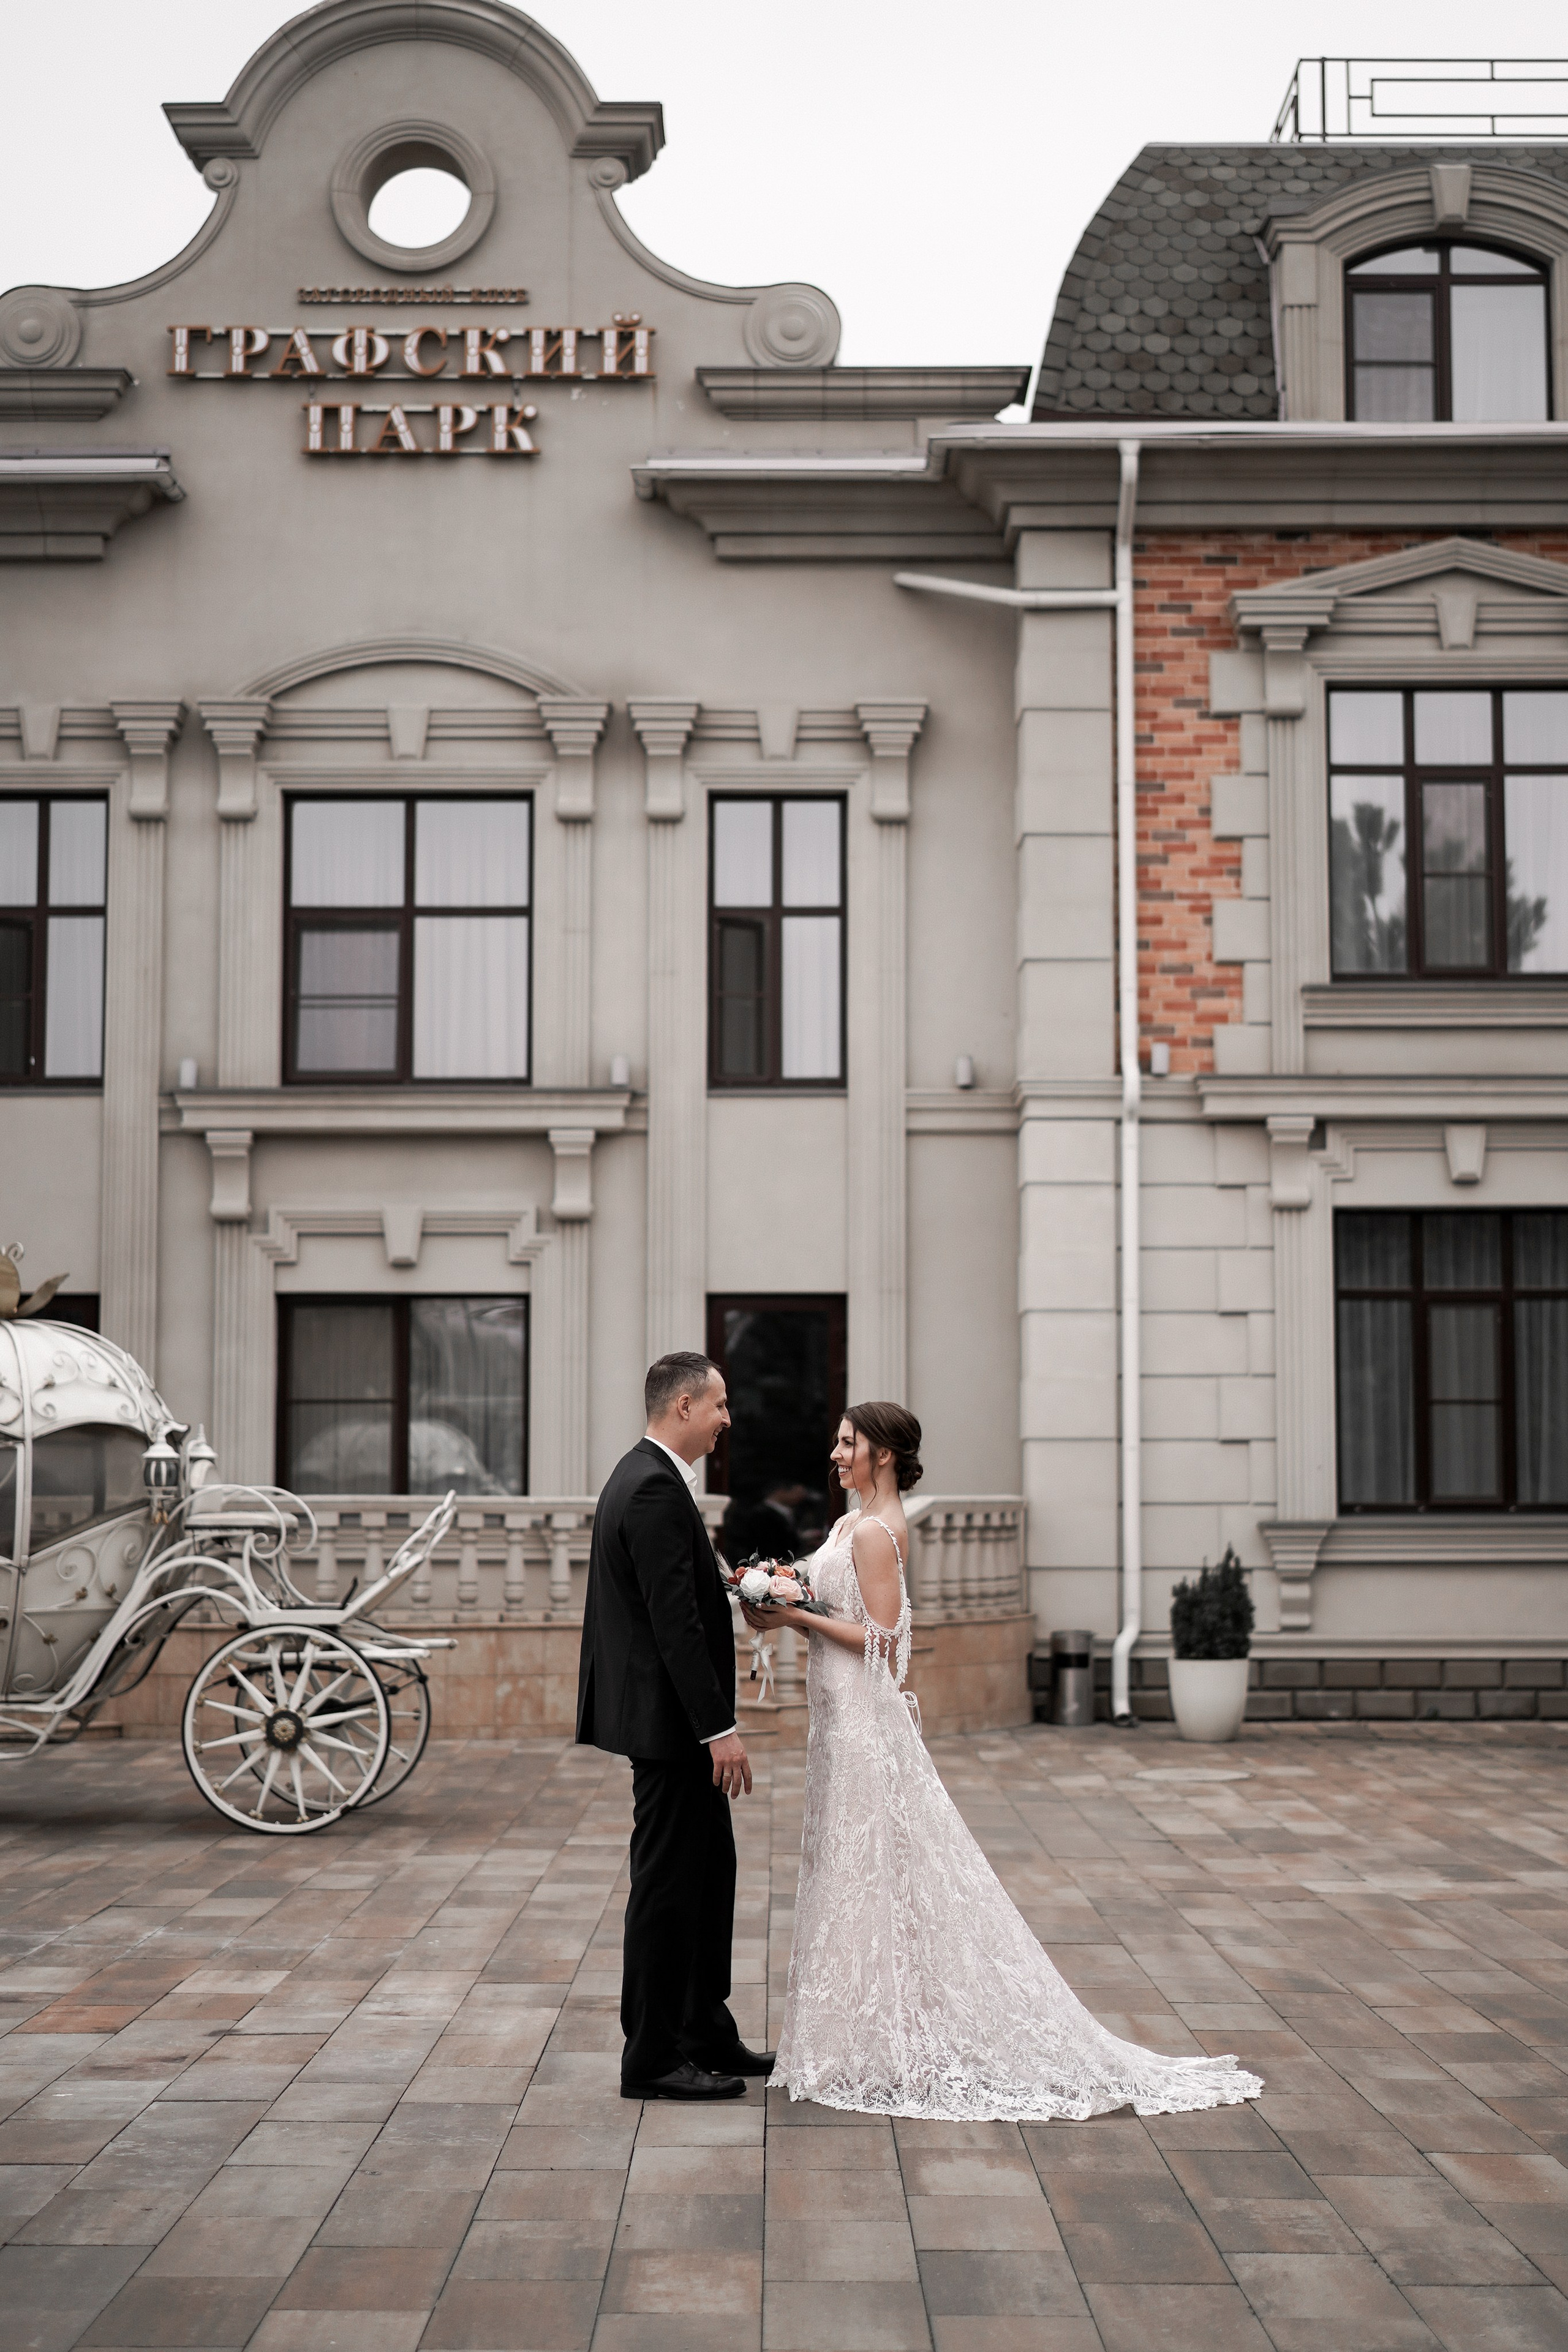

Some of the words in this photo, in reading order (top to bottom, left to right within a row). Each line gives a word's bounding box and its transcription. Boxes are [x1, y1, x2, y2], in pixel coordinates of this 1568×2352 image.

[298, 284, 454, 304] ЗАГОРОДНЫЙ
[470, 288, 527, 303] КЛУБ
[167, 312, 656, 377] ГРАФСКИЙ
[303, 404, 540, 454] ПАРК
